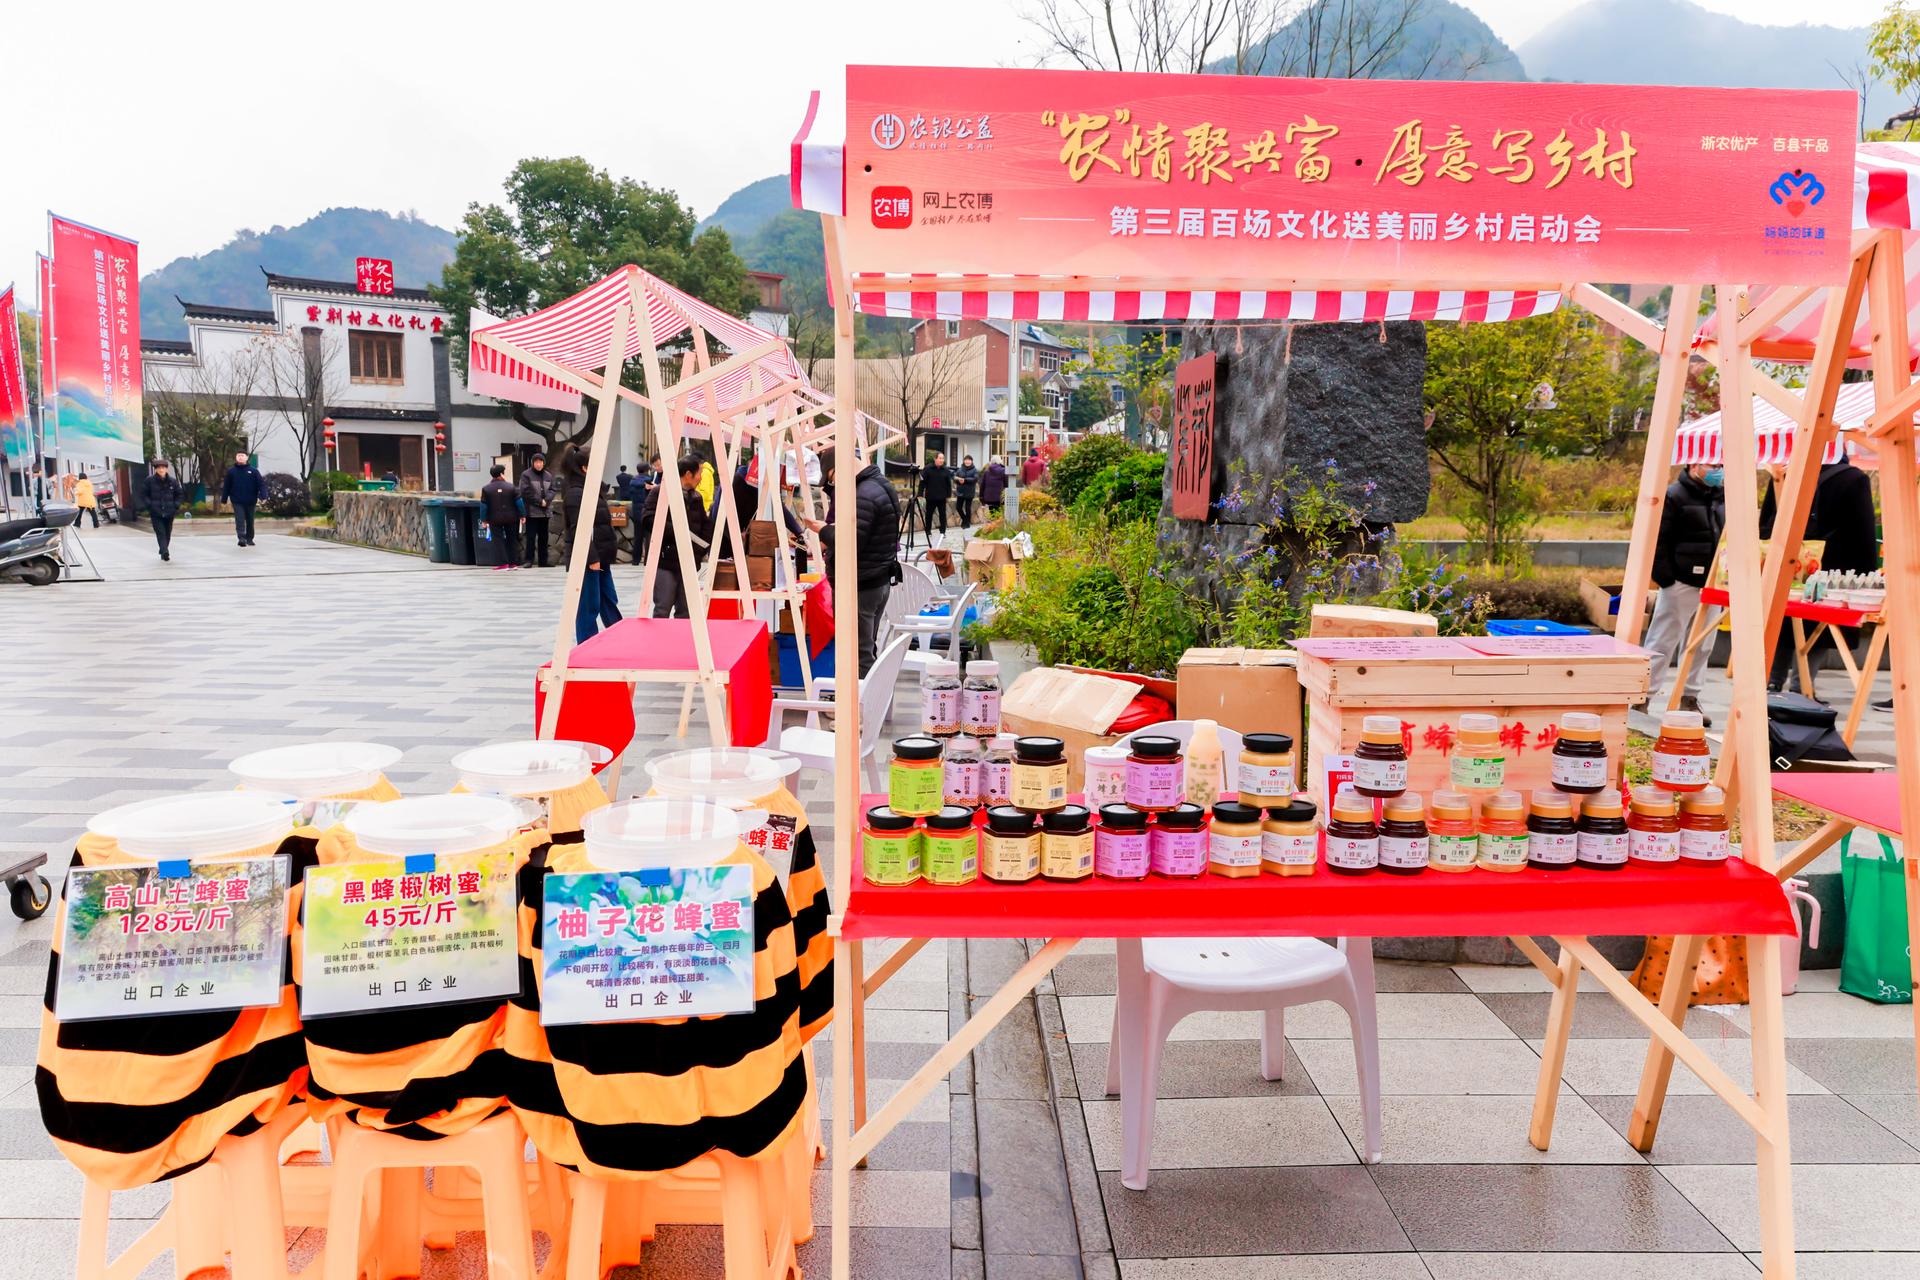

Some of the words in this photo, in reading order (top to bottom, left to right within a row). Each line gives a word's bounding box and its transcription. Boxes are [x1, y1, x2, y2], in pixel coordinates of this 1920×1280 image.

[908, 113, 994, 140] 农银公益
[1373, 118, 1638, 190] 厚意写乡村
[1701, 136, 1759, 151] 浙农优产
[1773, 138, 1829, 152] 百县千品
[923, 191, 993, 209] 网上农博
[1109, 205, 1602, 244] 第三届百场文化送美丽乡村启动会
[306, 305, 444, 333] 紫荆村文化礼堂
[105, 878, 250, 910] 高山土蜂蜜
[343, 872, 481, 904] 黑蜂椴树蜜
[119, 906, 233, 936] 128元/斤
[365, 901, 457, 928] 45元/斤
[558, 901, 742, 939] 柚子花蜂蜜
[123, 981, 215, 1001] 出口企业
[369, 976, 457, 996] 出口企业
[605, 990, 693, 1009] 出口企业
